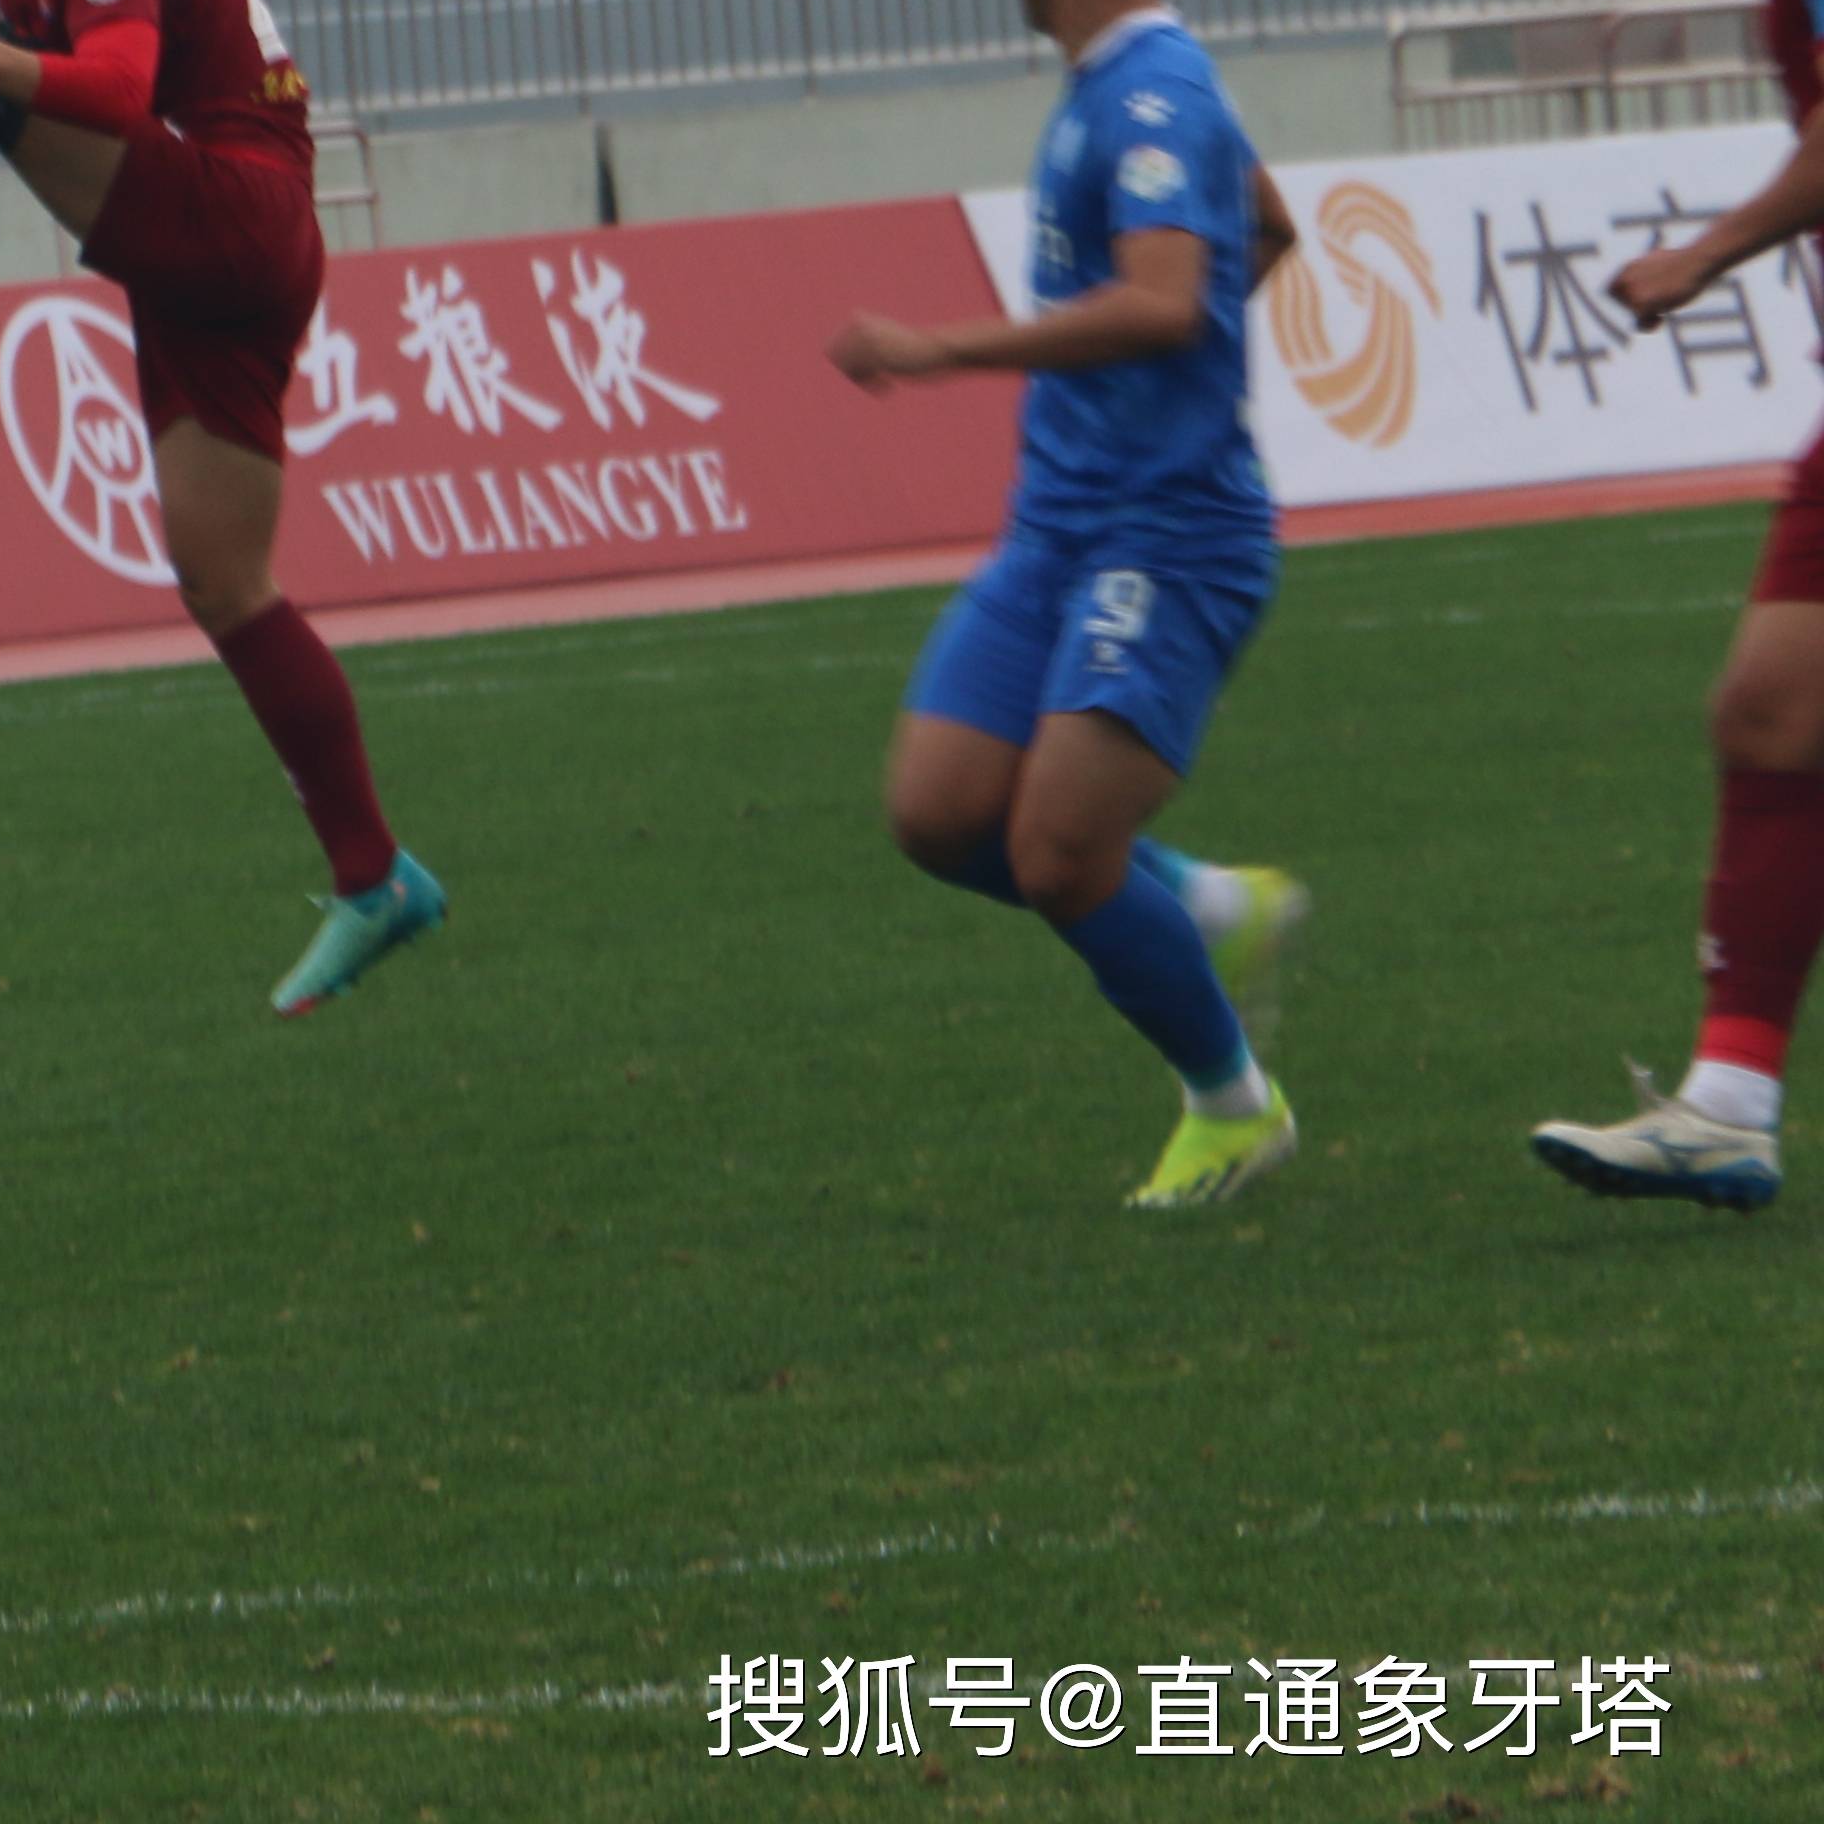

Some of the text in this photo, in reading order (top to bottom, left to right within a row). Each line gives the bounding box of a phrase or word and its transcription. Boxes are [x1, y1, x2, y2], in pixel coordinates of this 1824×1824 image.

[282, 246, 723, 456] 五粮液
[1472, 186, 1824, 414] 体育
[322, 448, 748, 565] WULIANGYE
